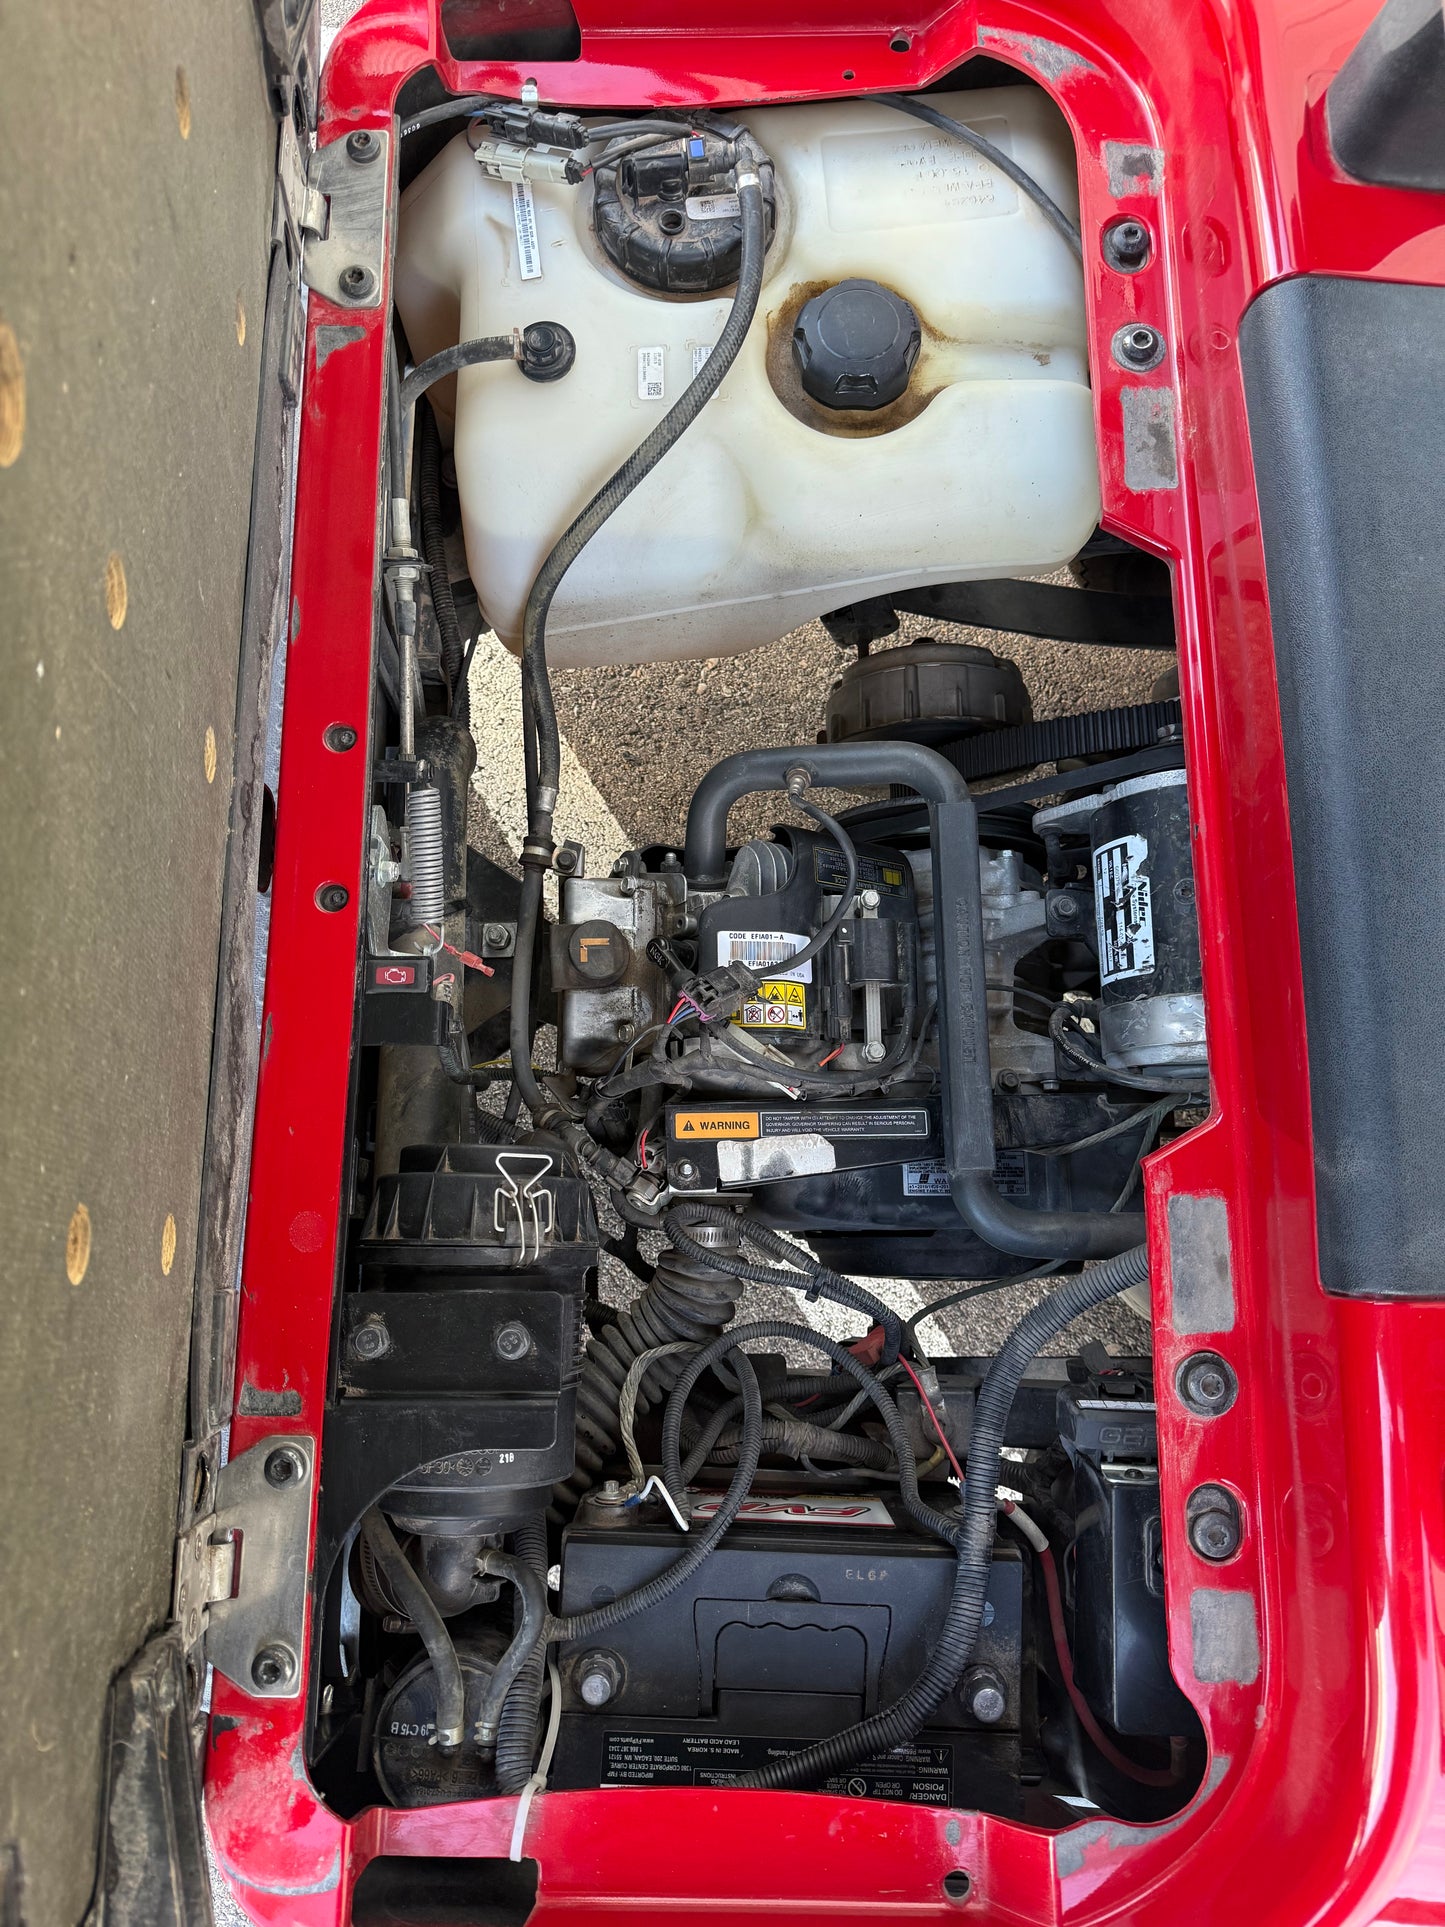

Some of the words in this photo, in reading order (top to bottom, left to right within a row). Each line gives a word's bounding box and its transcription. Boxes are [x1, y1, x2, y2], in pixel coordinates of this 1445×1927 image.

[1137, 881, 1149, 927] Nidec
[650, 946, 665, 965] NGK
[699, 1121, 750, 1130] WARNING
[391, 1721, 399, 1733] B
[916, 1766, 949, 1774] WARNING:
[699, 1771, 737, 1779] INSTRUCTIONS
[912, 1782, 944, 1791] POISON
[909, 1792, 947, 1801] DANGER/
